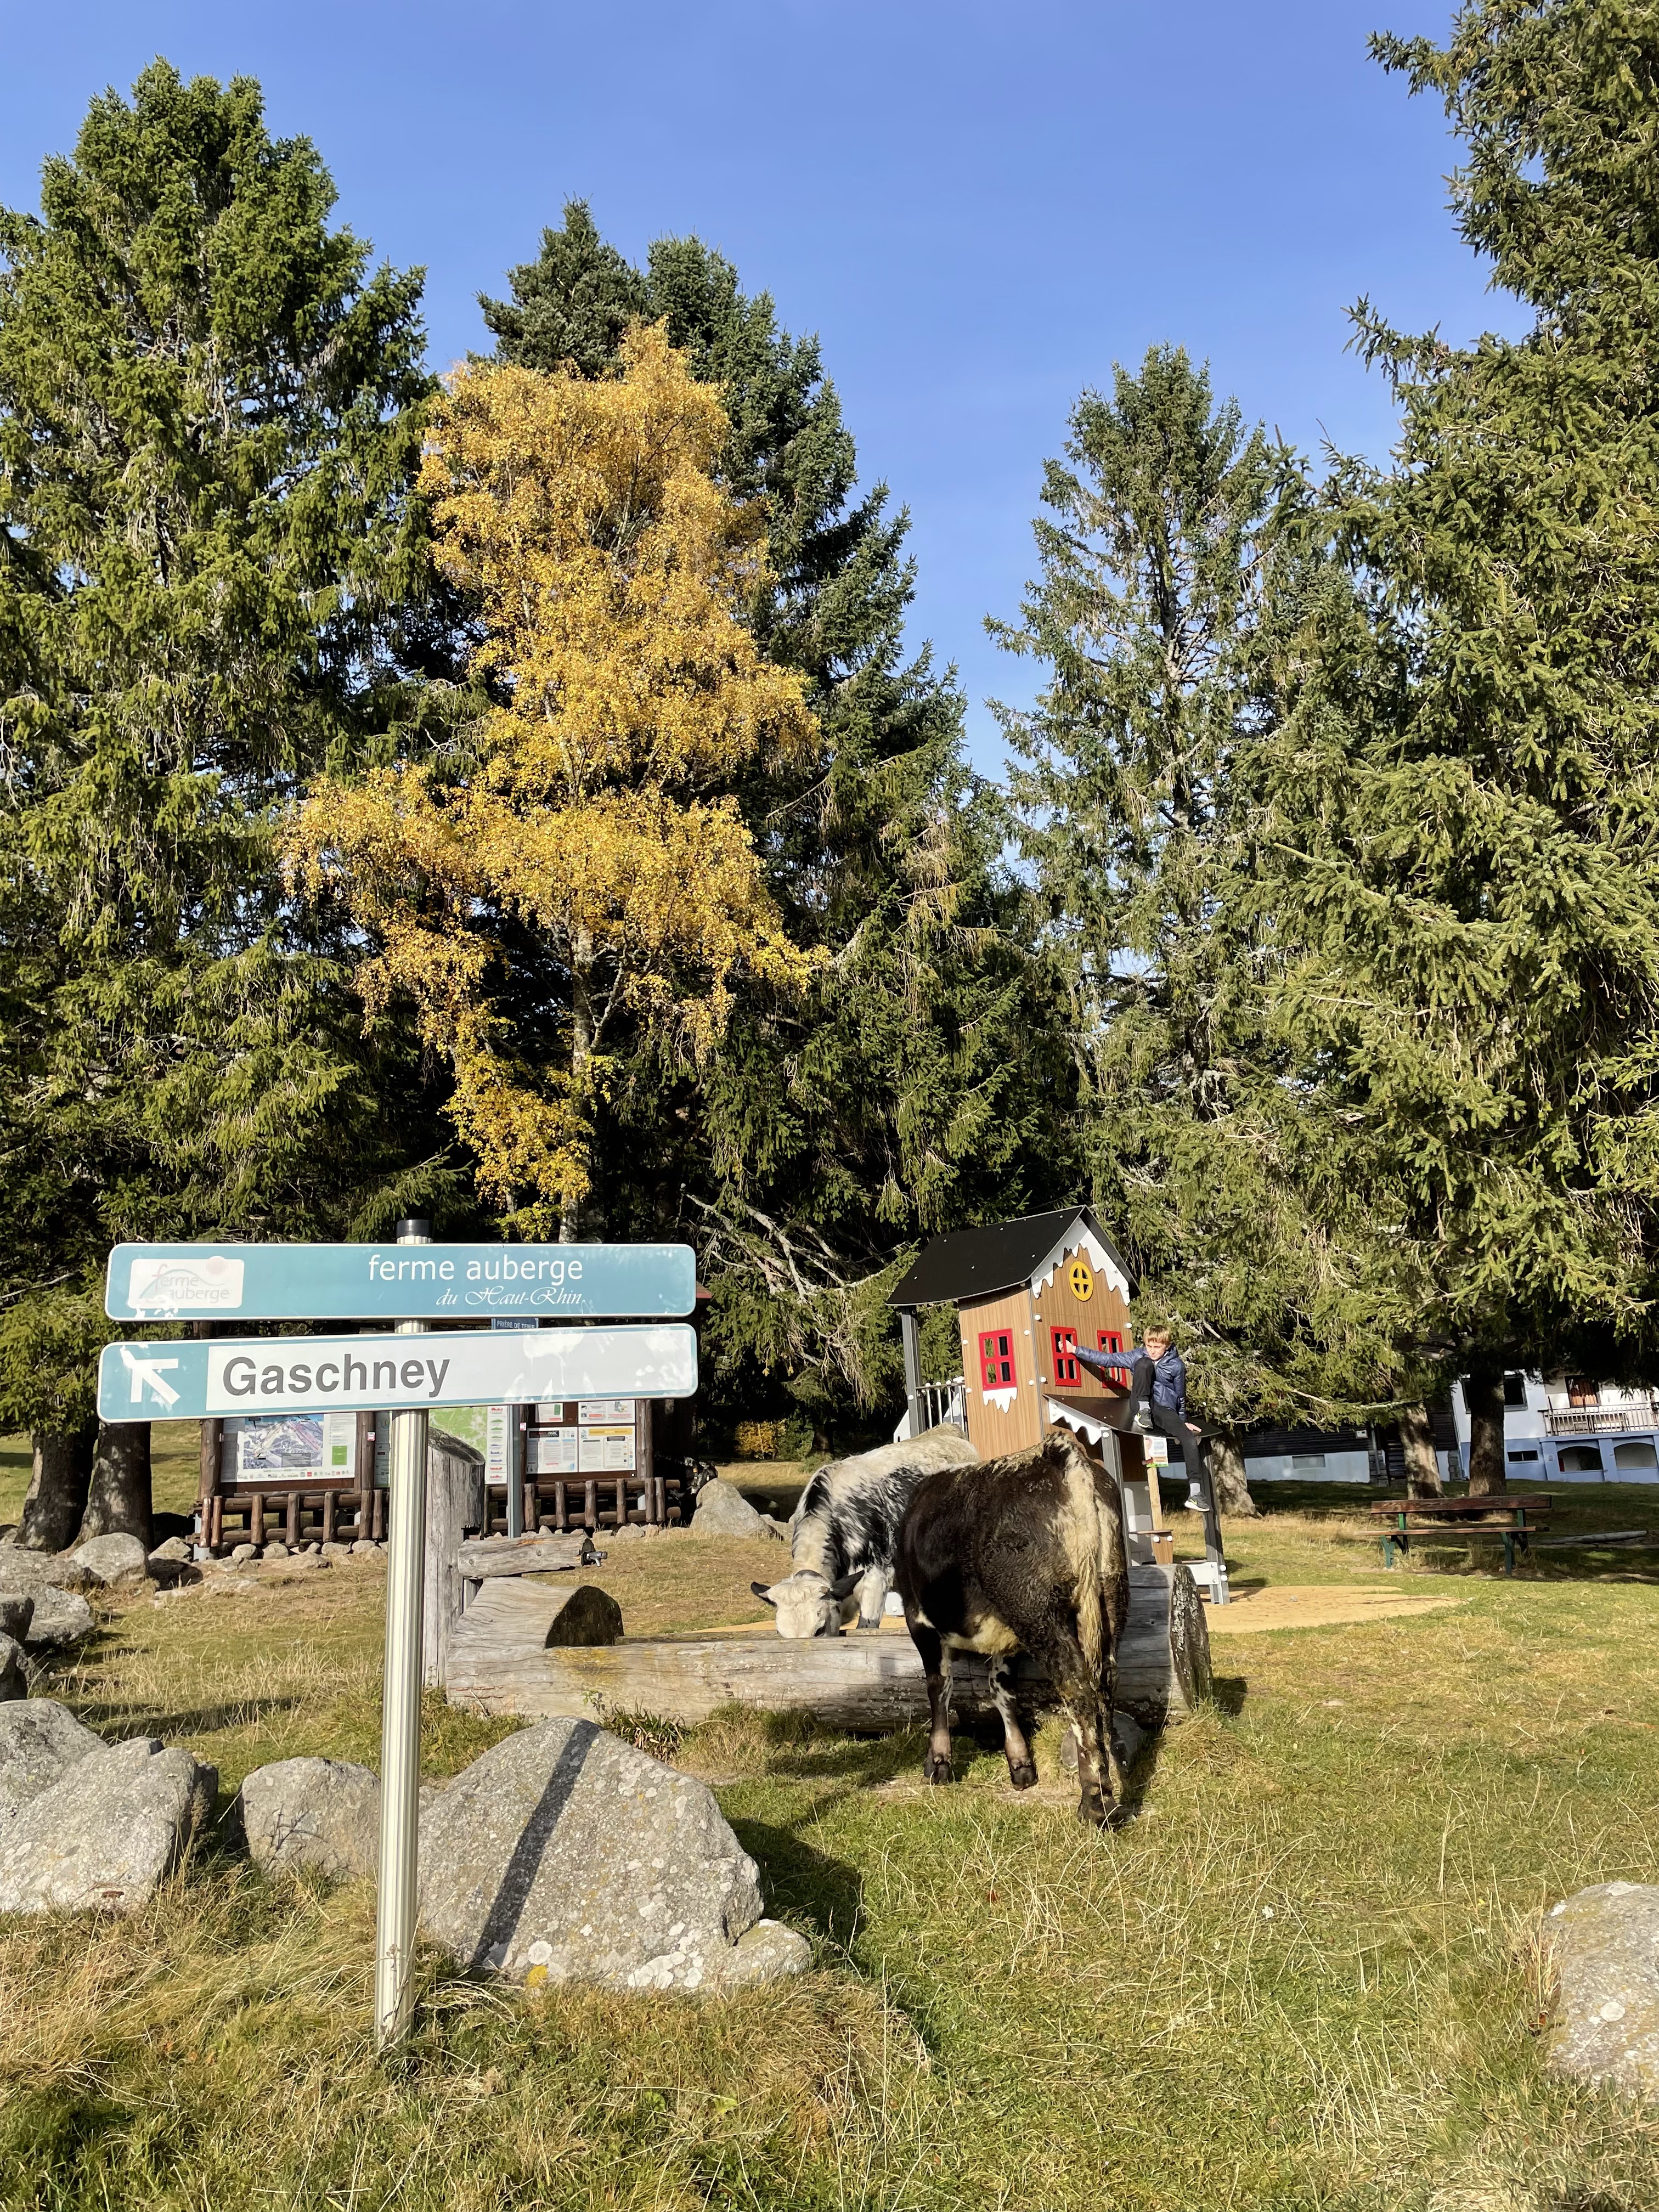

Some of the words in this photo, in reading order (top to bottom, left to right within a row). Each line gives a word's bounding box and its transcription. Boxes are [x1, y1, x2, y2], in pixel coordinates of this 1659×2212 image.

[151, 1263, 199, 1294] ferme
[369, 1254, 455, 1280] ferme
[466, 1254, 583, 1286] auberge
[436, 1288, 458, 1306] du
[465, 1285, 583, 1305] Haut-Rhin
[223, 1353, 450, 1398] Gaschney
